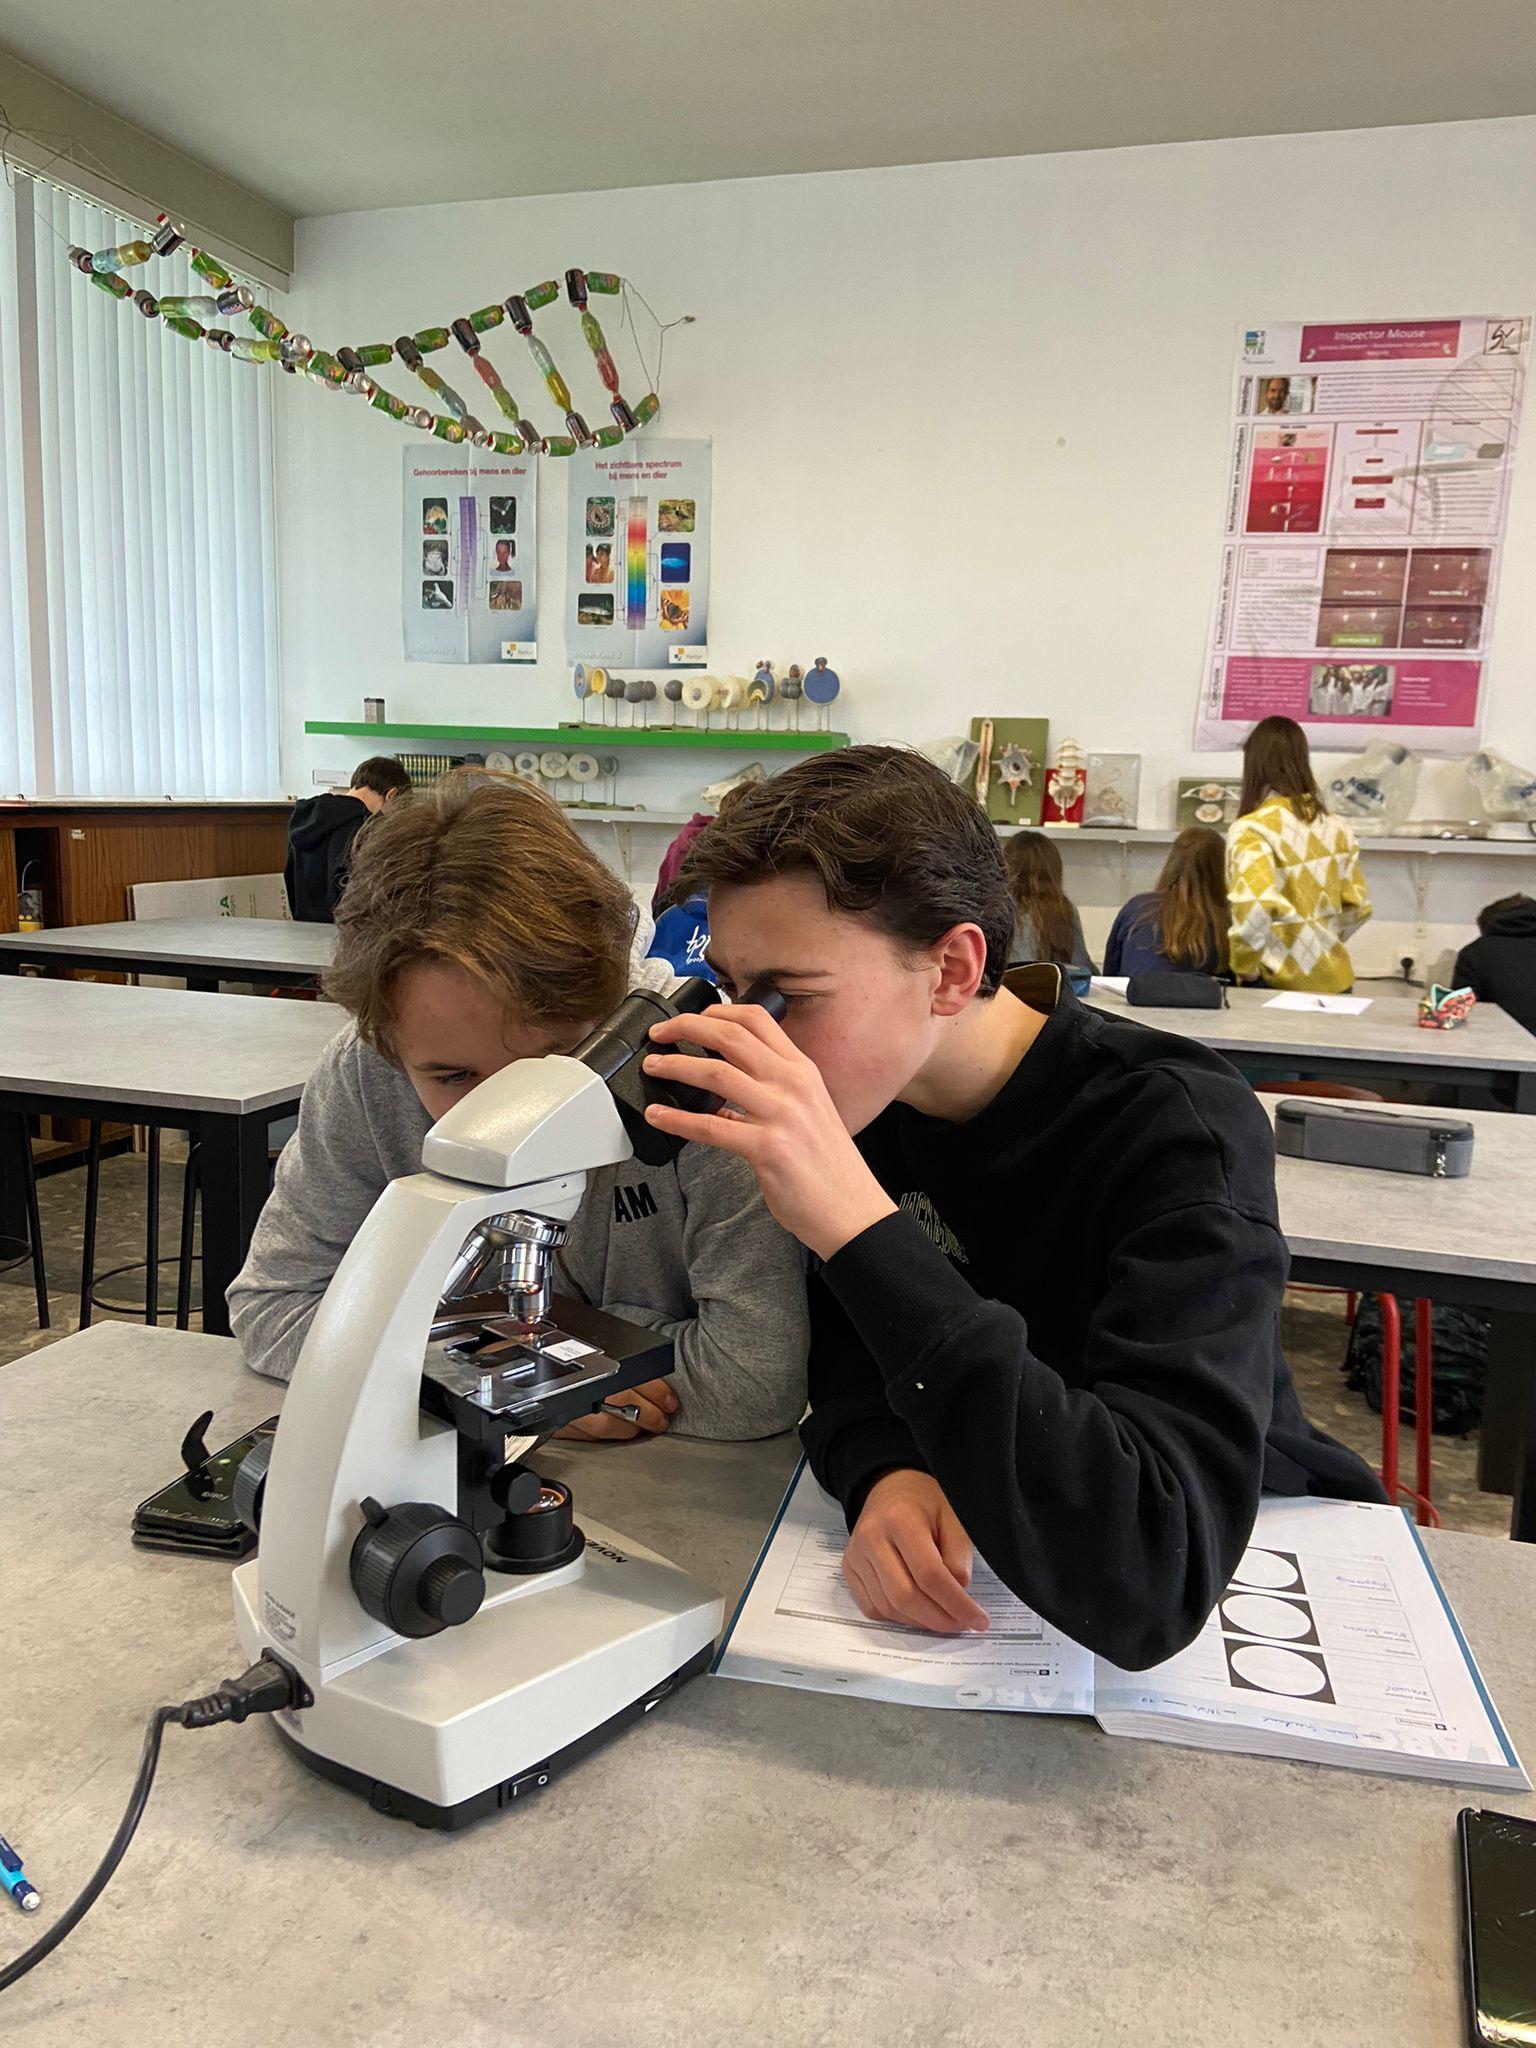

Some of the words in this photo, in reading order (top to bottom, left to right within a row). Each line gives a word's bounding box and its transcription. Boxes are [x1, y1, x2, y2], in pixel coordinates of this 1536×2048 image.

[1334, 330, 1385, 342] Inspector
[1387, 329, 1426, 339] Mouse
[595, 462, 608, 470] Het
[610, 461, 644, 469] zichtbare
[646, 460, 682, 469] spectrum
[512, 467, 527, 475] dier
[609, 472, 618, 481] bij
[652, 471, 667, 479] dier
[613, 1181, 659, 1223] AM
